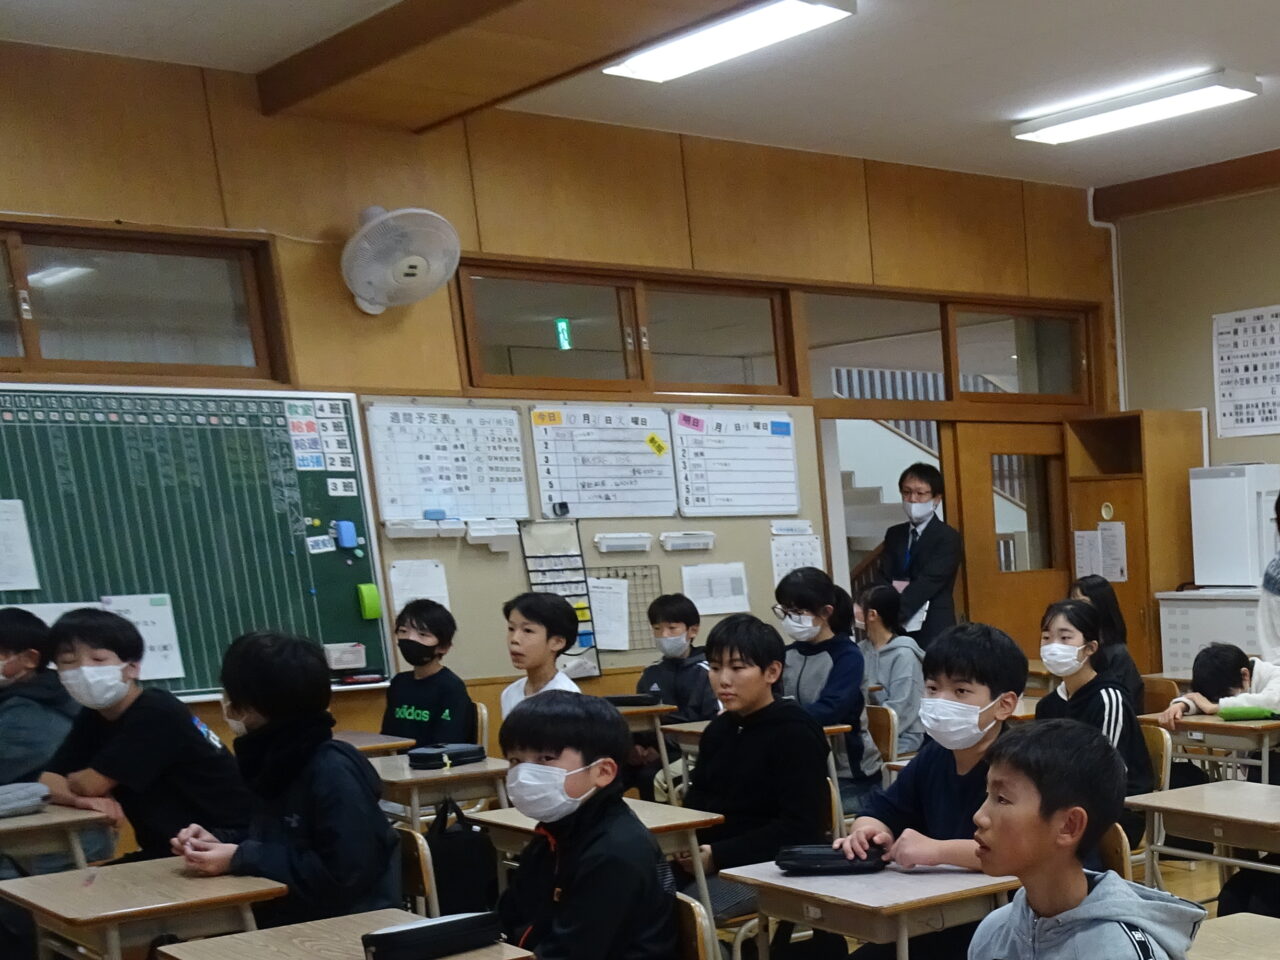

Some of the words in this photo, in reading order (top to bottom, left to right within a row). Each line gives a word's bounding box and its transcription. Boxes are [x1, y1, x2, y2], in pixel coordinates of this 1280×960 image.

[390, 412, 450, 424] 週間予定表
